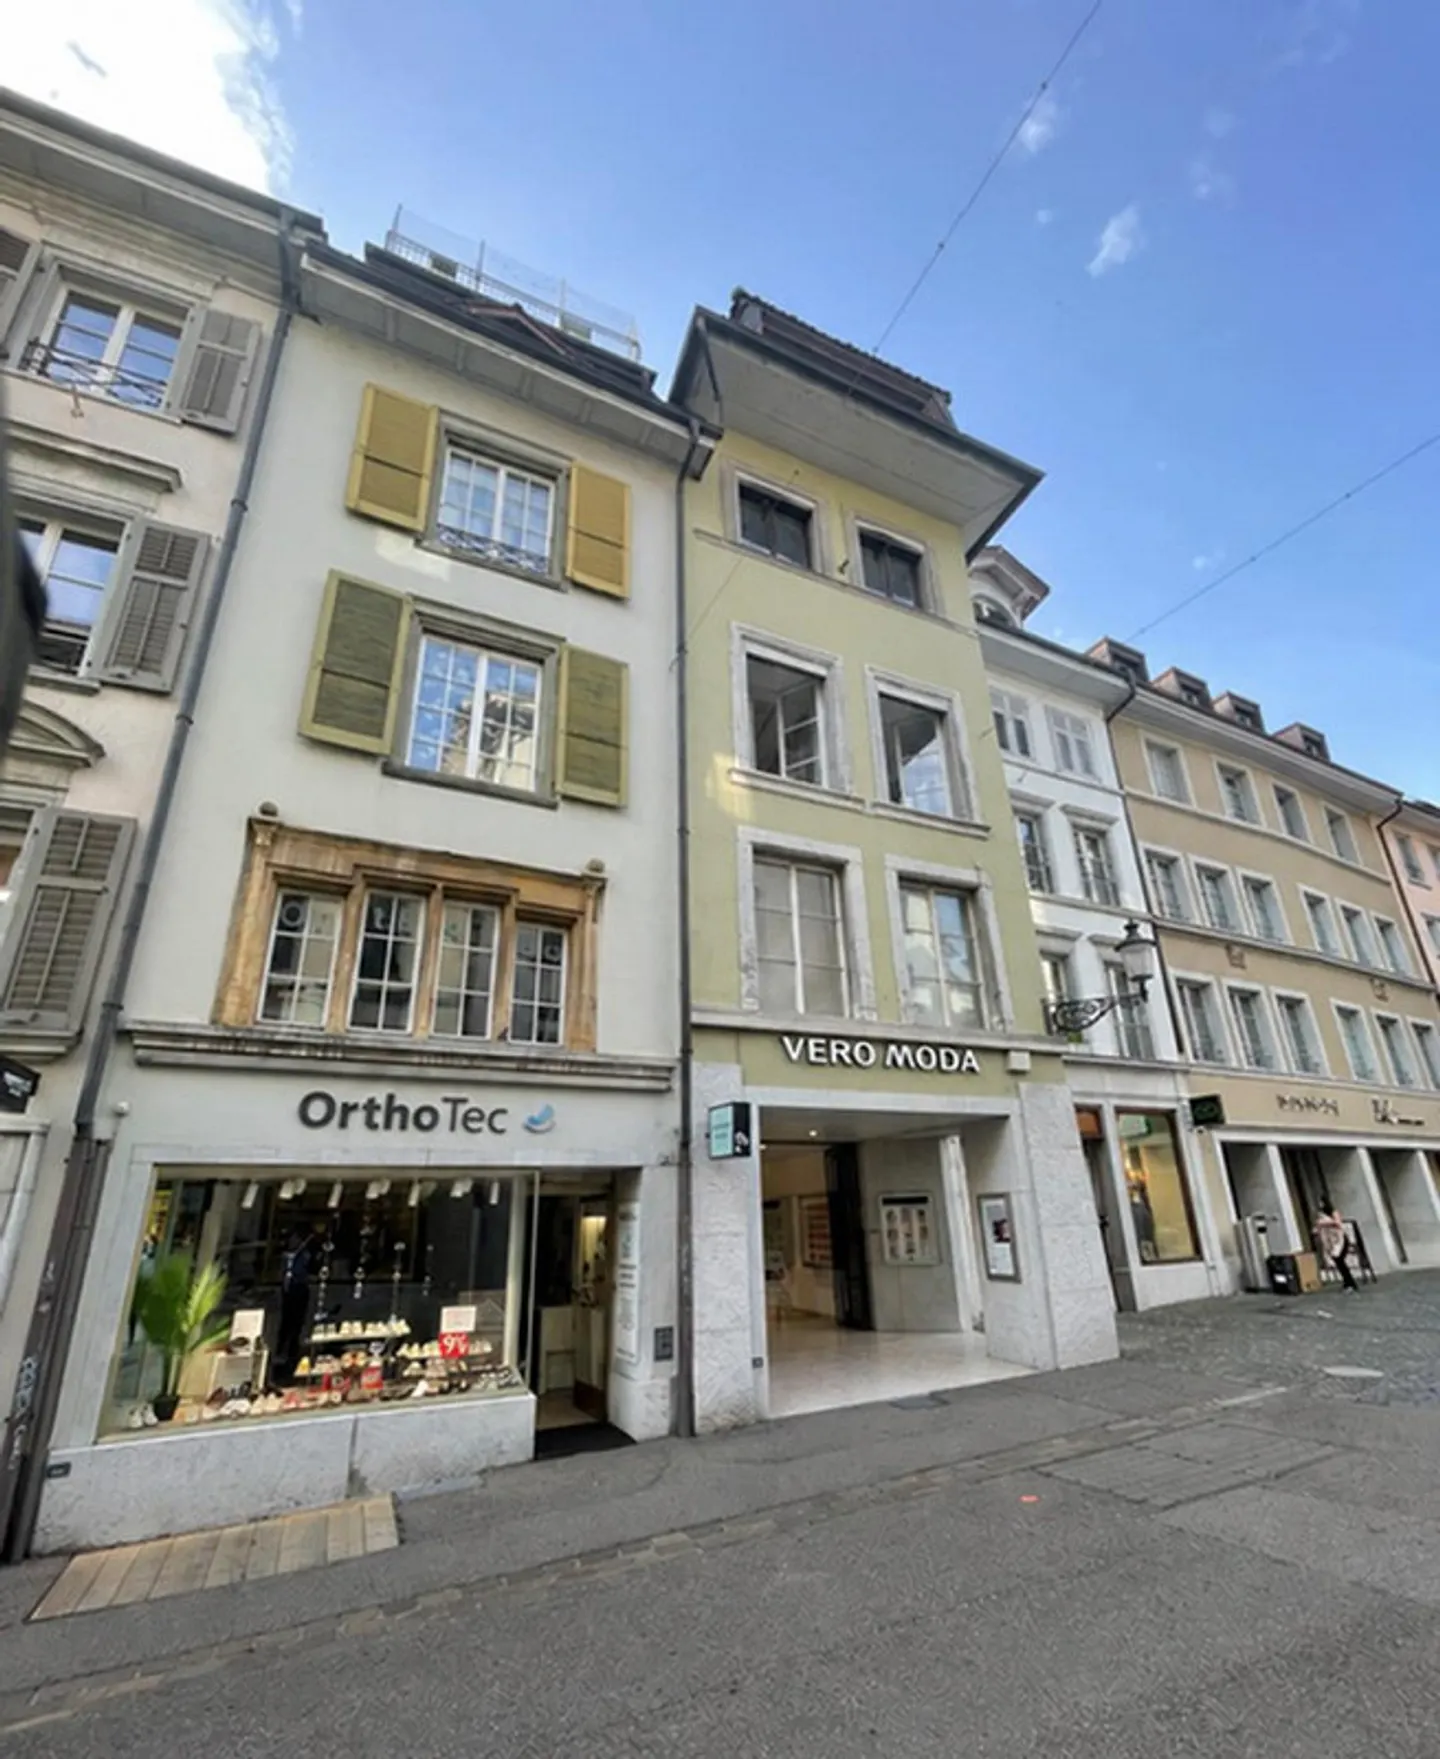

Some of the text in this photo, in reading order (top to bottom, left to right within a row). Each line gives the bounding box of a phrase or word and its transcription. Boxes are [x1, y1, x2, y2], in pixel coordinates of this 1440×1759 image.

[782, 1035, 981, 1073] VERO MODA
[298, 1090, 509, 1135] OrthoTec
